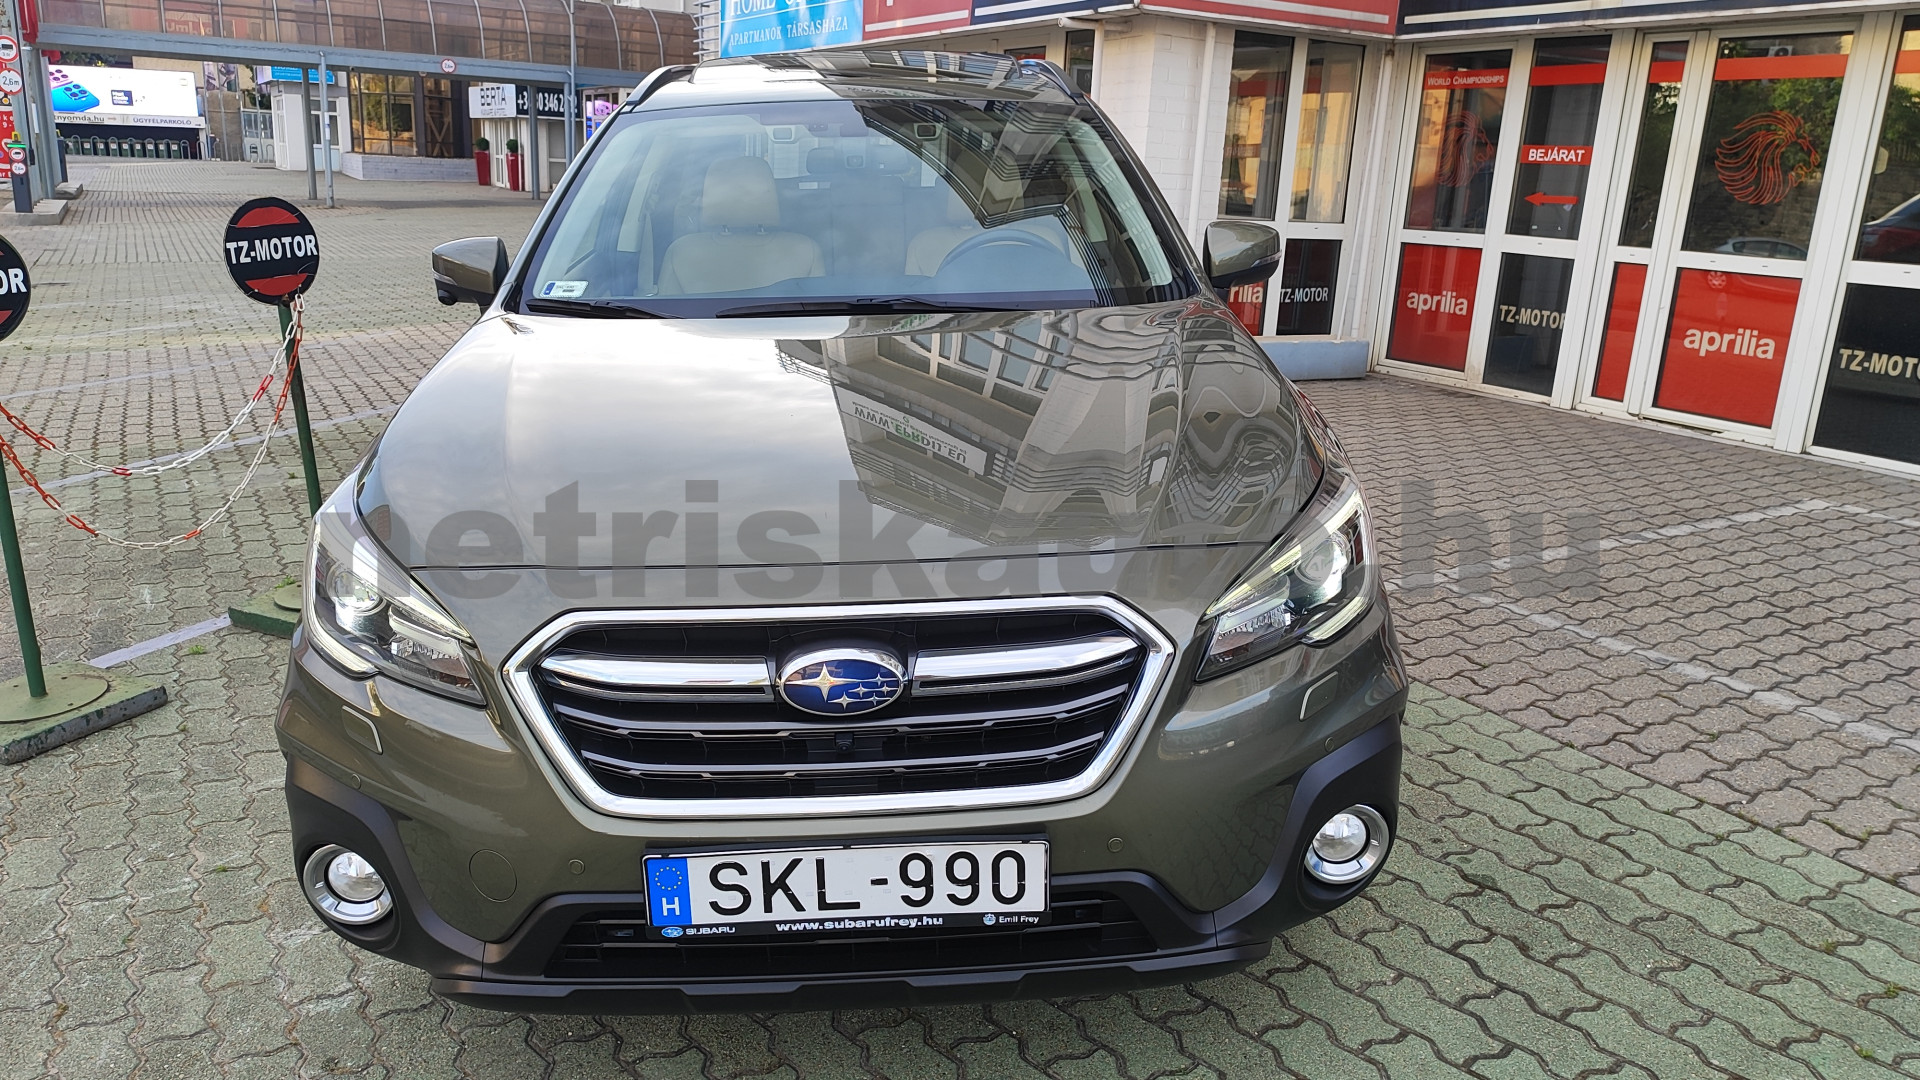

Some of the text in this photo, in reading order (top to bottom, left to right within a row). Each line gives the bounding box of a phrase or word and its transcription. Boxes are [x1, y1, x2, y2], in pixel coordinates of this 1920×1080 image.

[729, 15, 849, 46] APARTMANOK TÁRSASHÁZA
[2, 75, 20, 86] 2,6m
[480, 86, 507, 106] BERTA
[1528, 146, 1586, 162] BEJÁRAT
[226, 234, 318, 265] TZ-MOTOR
[1280, 287, 1329, 303] TZ-MOTOR
[1406, 290, 1468, 316] aprilia
[1683, 328, 1776, 360] aprilia
[1839, 348, 1920, 381] TZ-MOT
[708, 849, 1027, 917] SKL-990
[661, 896, 681, 917] H
[775, 916, 943, 932] www.subarufrey.hu
[999, 915, 1040, 925] Emil Frey
[685, 926, 736, 936] SUBARU
